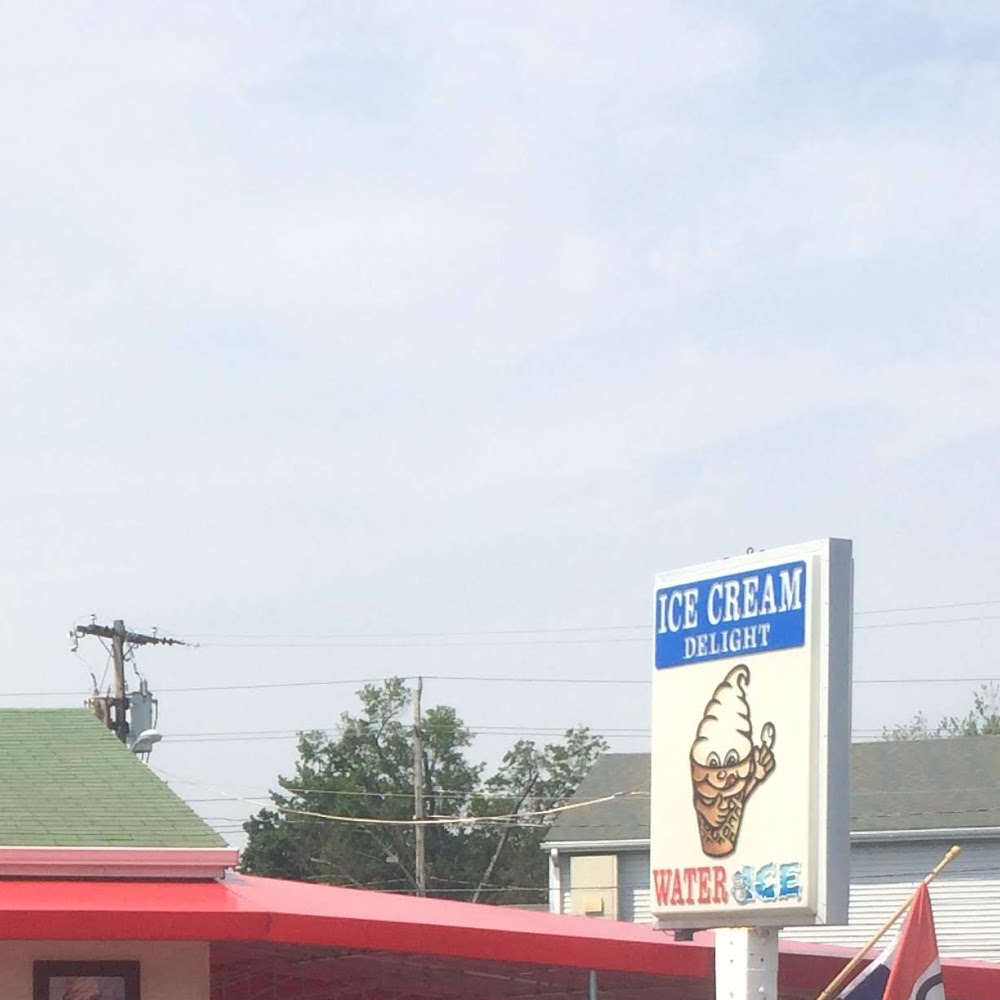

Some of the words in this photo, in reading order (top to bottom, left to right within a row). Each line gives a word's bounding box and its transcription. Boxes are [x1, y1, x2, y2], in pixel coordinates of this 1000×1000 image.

[658, 588, 699, 634] ICE
[707, 568, 803, 625] CREAM
[683, 622, 770, 659] DELIGHT
[653, 865, 729, 906] WATER
[738, 862, 803, 903] ICE
